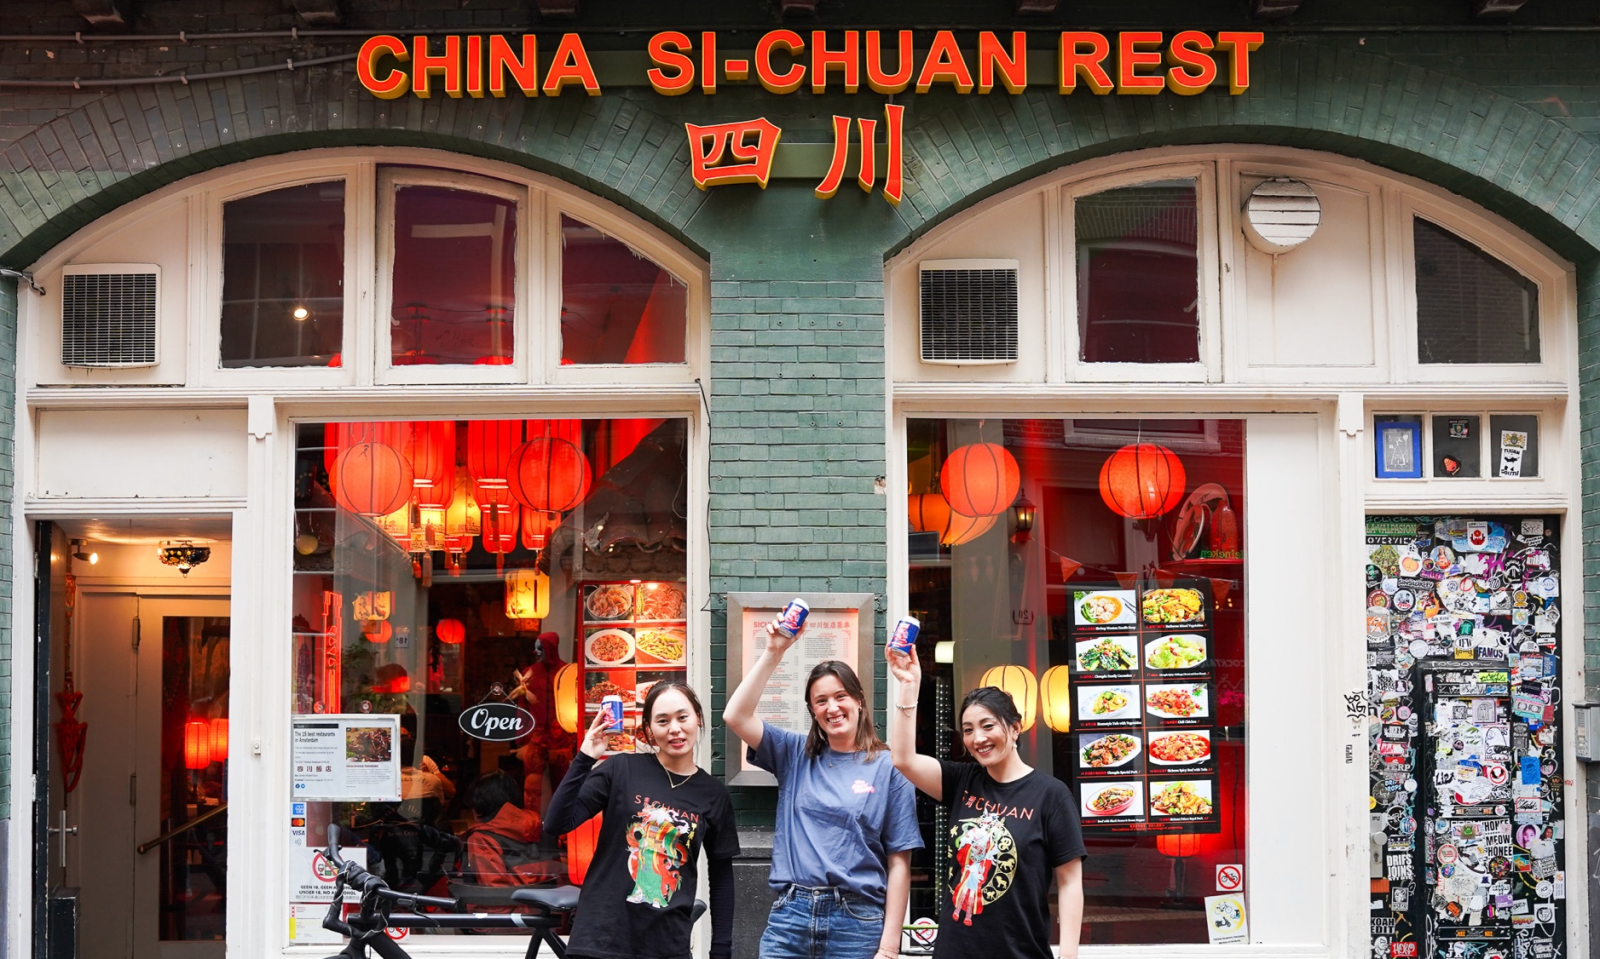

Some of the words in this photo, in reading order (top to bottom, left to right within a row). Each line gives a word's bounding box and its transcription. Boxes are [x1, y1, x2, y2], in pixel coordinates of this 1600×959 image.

[357, 33, 601, 98] CHINA
[647, 29, 1027, 96] SI-CHUAN
[1057, 30, 1264, 96] REST
[685, 103, 904, 205] 四川
[471, 708, 523, 736] Open
[1488, 846, 1512, 857] HONEE
